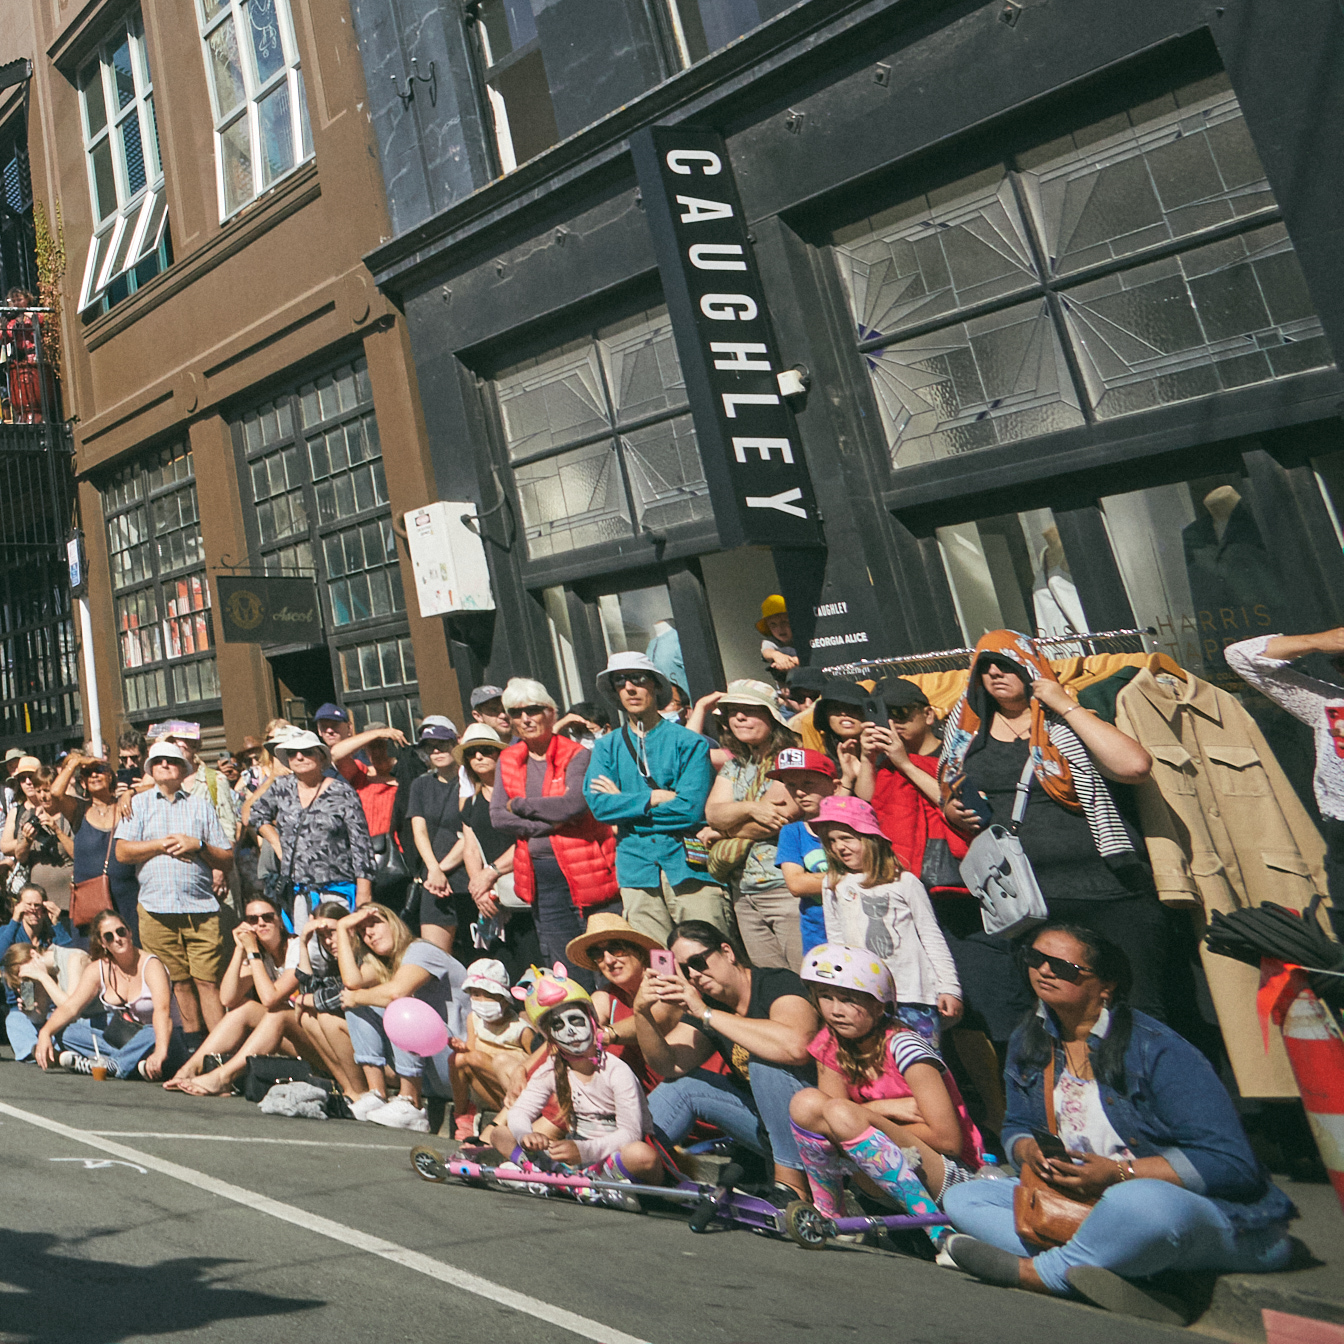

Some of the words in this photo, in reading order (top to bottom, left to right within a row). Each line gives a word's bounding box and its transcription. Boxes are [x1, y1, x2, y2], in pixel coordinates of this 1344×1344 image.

[665, 148, 808, 520] CAUGHLEY
[812, 601, 848, 617] CAUGHLEY
[1155, 604, 1272, 636] HARRIS
[809, 634, 845, 649] GEORGIA
[844, 631, 869, 644] ALICE
[1163, 635, 1255, 663] TAPP
